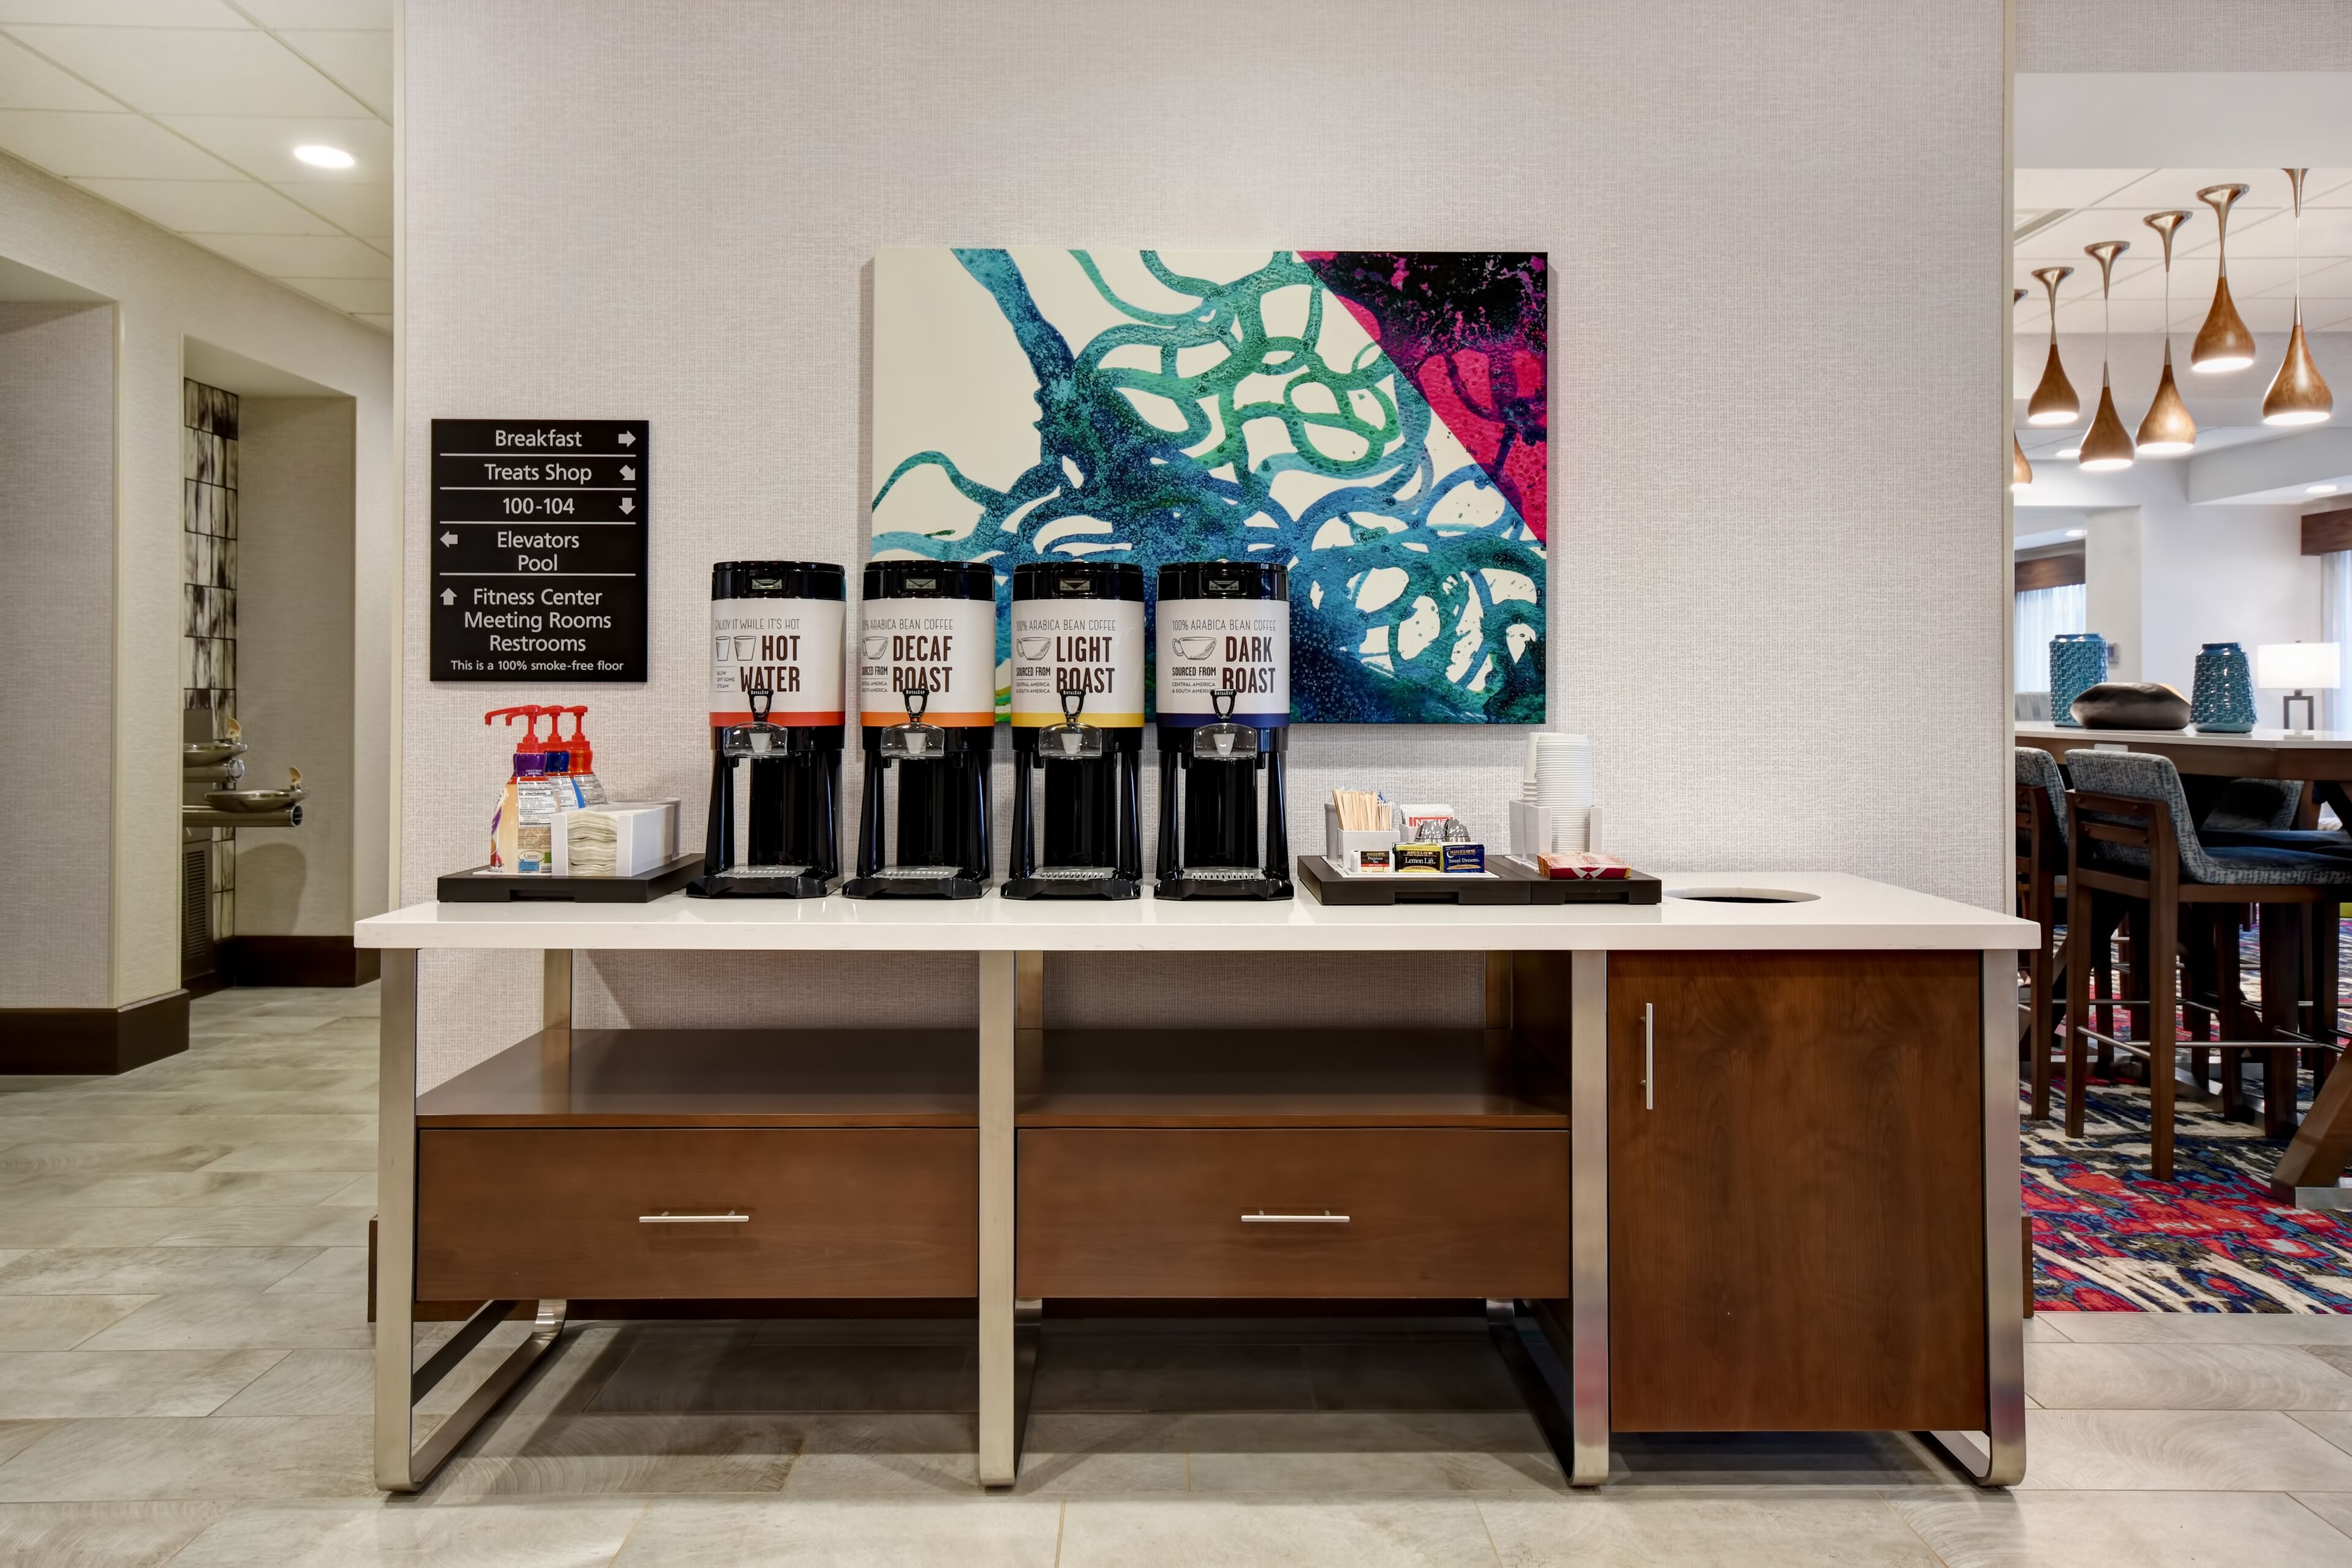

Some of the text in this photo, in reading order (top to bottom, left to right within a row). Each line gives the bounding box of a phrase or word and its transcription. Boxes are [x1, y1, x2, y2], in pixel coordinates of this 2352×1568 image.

[495, 429, 582, 447] Breakfast
[484, 464, 592, 484] Treats Shop
[502, 497, 575, 514] 100-104
[497, 531, 579, 548] Elevators
[518, 554, 558, 571] Pool
[473, 588, 603, 606] Fitness Center
[464, 611, 611, 632] Meeting Rooms
[715, 619, 800, 630] ENJOY IT WHILE IT'S HOT
[870, 619, 897, 630] ARABICA
[900, 619, 921, 630] BEAN
[924, 619, 954, 630] COFFEE
[1029, 620, 1060, 631] ARABICA
[1063, 620, 1085, 630] BEAN
[1088, 620, 1116, 631] COFFEE
[1172, 619, 1276, 631] 100% ARABICA BEAN COFFEE
[490, 635, 586, 652] Restrooms
[762, 635, 801, 661] HOT
[893, 635, 952, 662] DECAF
[1057, 636, 1112, 662] LIGHT
[1226, 636, 1272, 662] DARK
[451, 660, 473, 670] This
[476, 660, 484, 670] is
[498, 660, 527, 670] 100%
[531, 660, 594, 670] smoke-free
[597, 660, 624, 670] floor
[875, 666, 888, 676] FROM
[1016, 666, 1050, 676] SOURCED FROM
[1172, 666, 1216, 676] SOURCED FROM
[740, 666, 800, 692] WATER
[893, 666, 952, 692] ROAST
[1057, 667, 1115, 693] ROAST
[1223, 667, 1276, 693] ROAST
